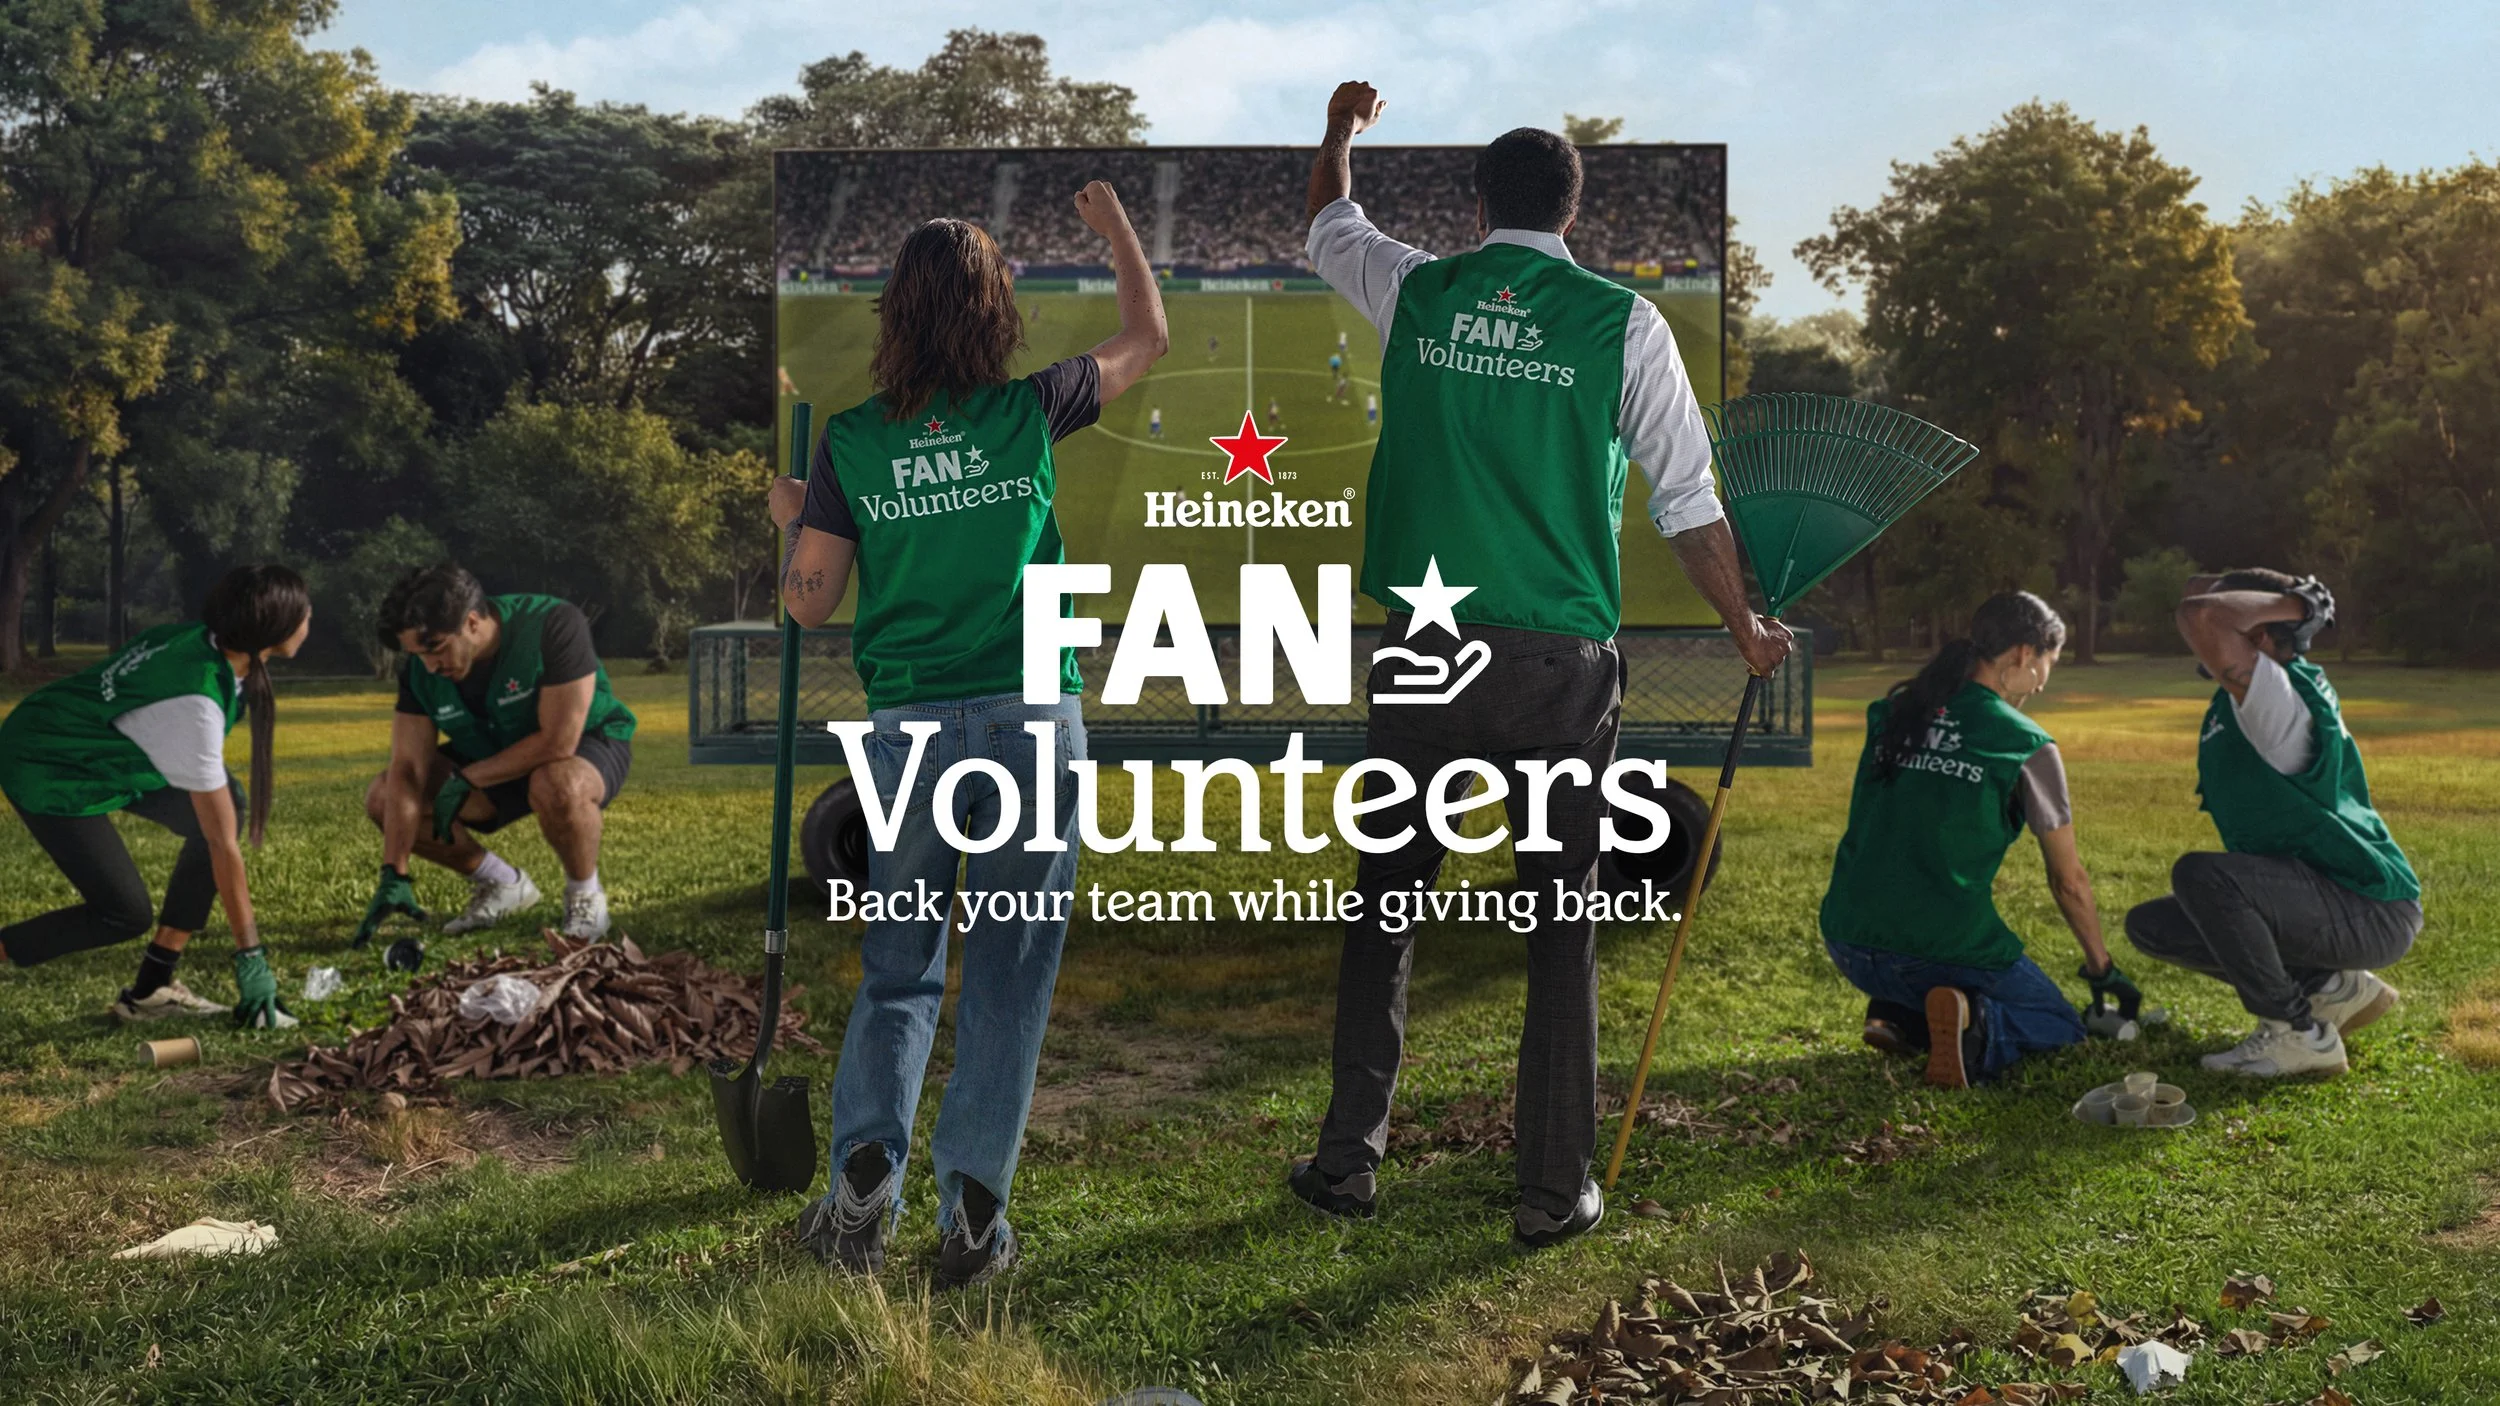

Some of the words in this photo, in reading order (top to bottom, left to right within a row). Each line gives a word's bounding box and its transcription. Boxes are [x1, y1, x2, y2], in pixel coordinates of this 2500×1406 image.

[1450, 312, 1519, 350] FAN
[1416, 337, 1576, 387] Volunteers
[891, 450, 964, 490] FAN
[858, 476, 1033, 522] Volunteers
